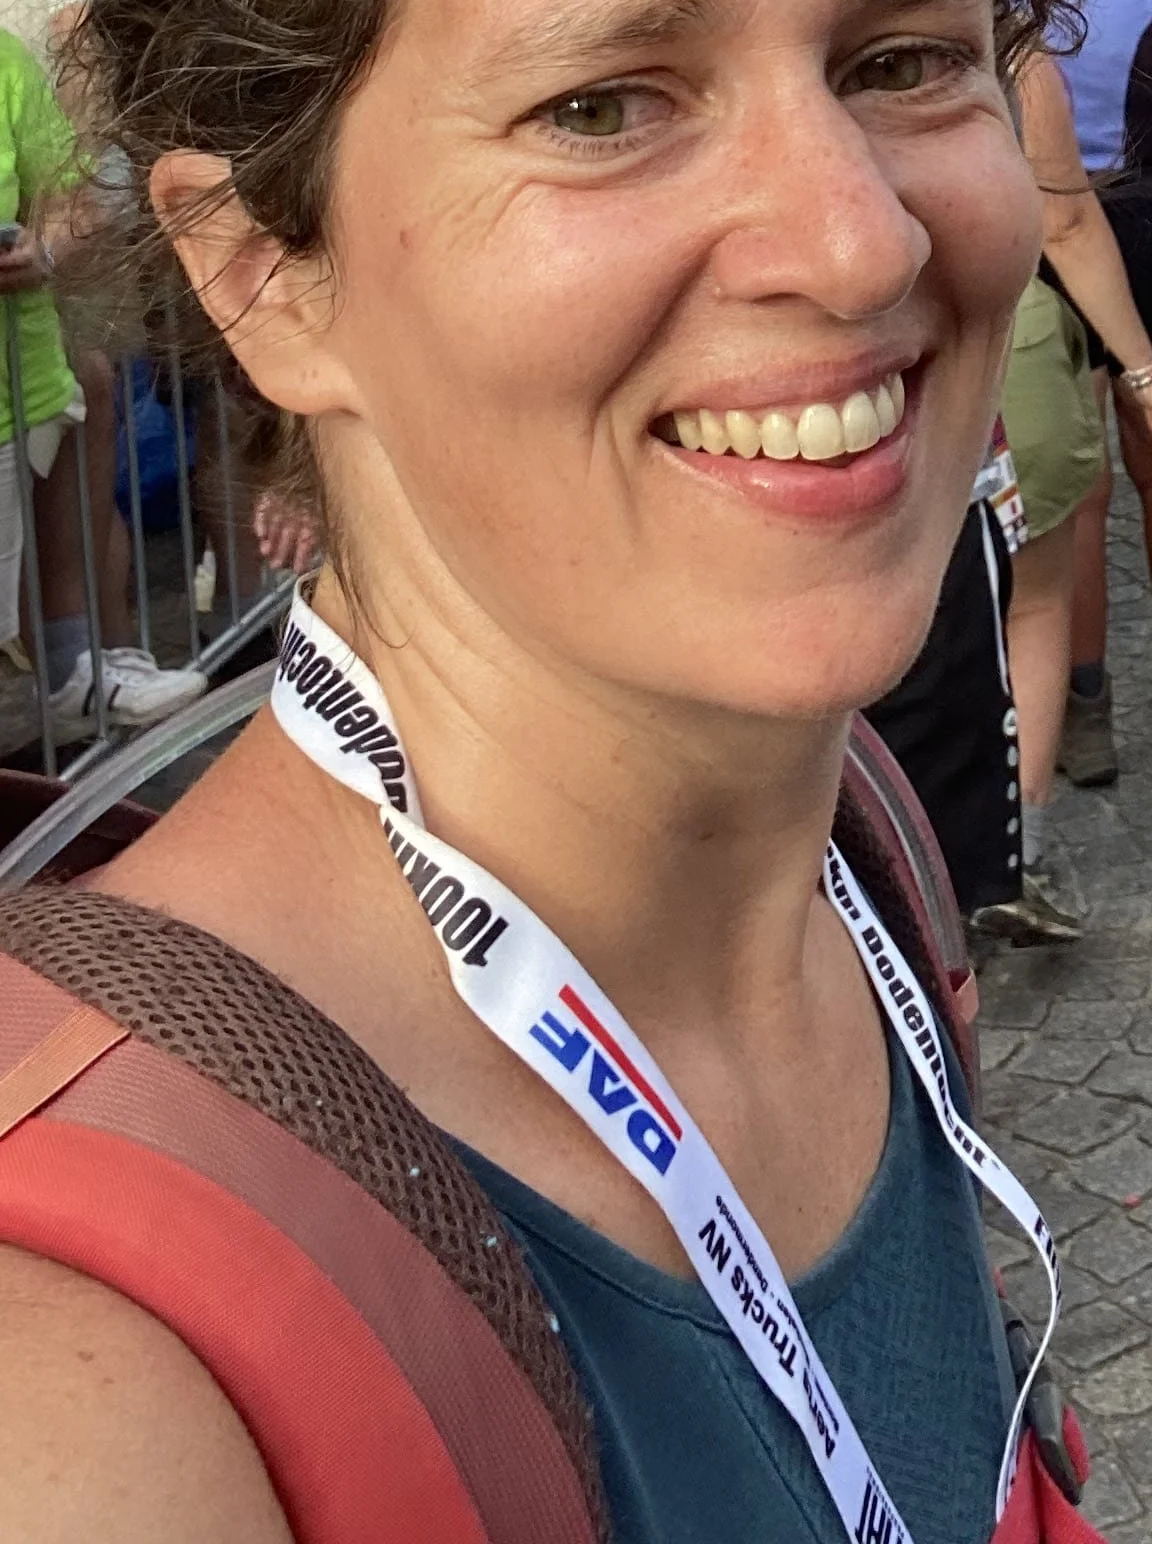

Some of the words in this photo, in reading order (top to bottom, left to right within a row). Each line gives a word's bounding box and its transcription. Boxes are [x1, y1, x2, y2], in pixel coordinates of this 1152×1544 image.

[529, 1010, 677, 1176] DAF
[698, 1218, 732, 1274] NV
[731, 1267, 798, 1378] Trucks
